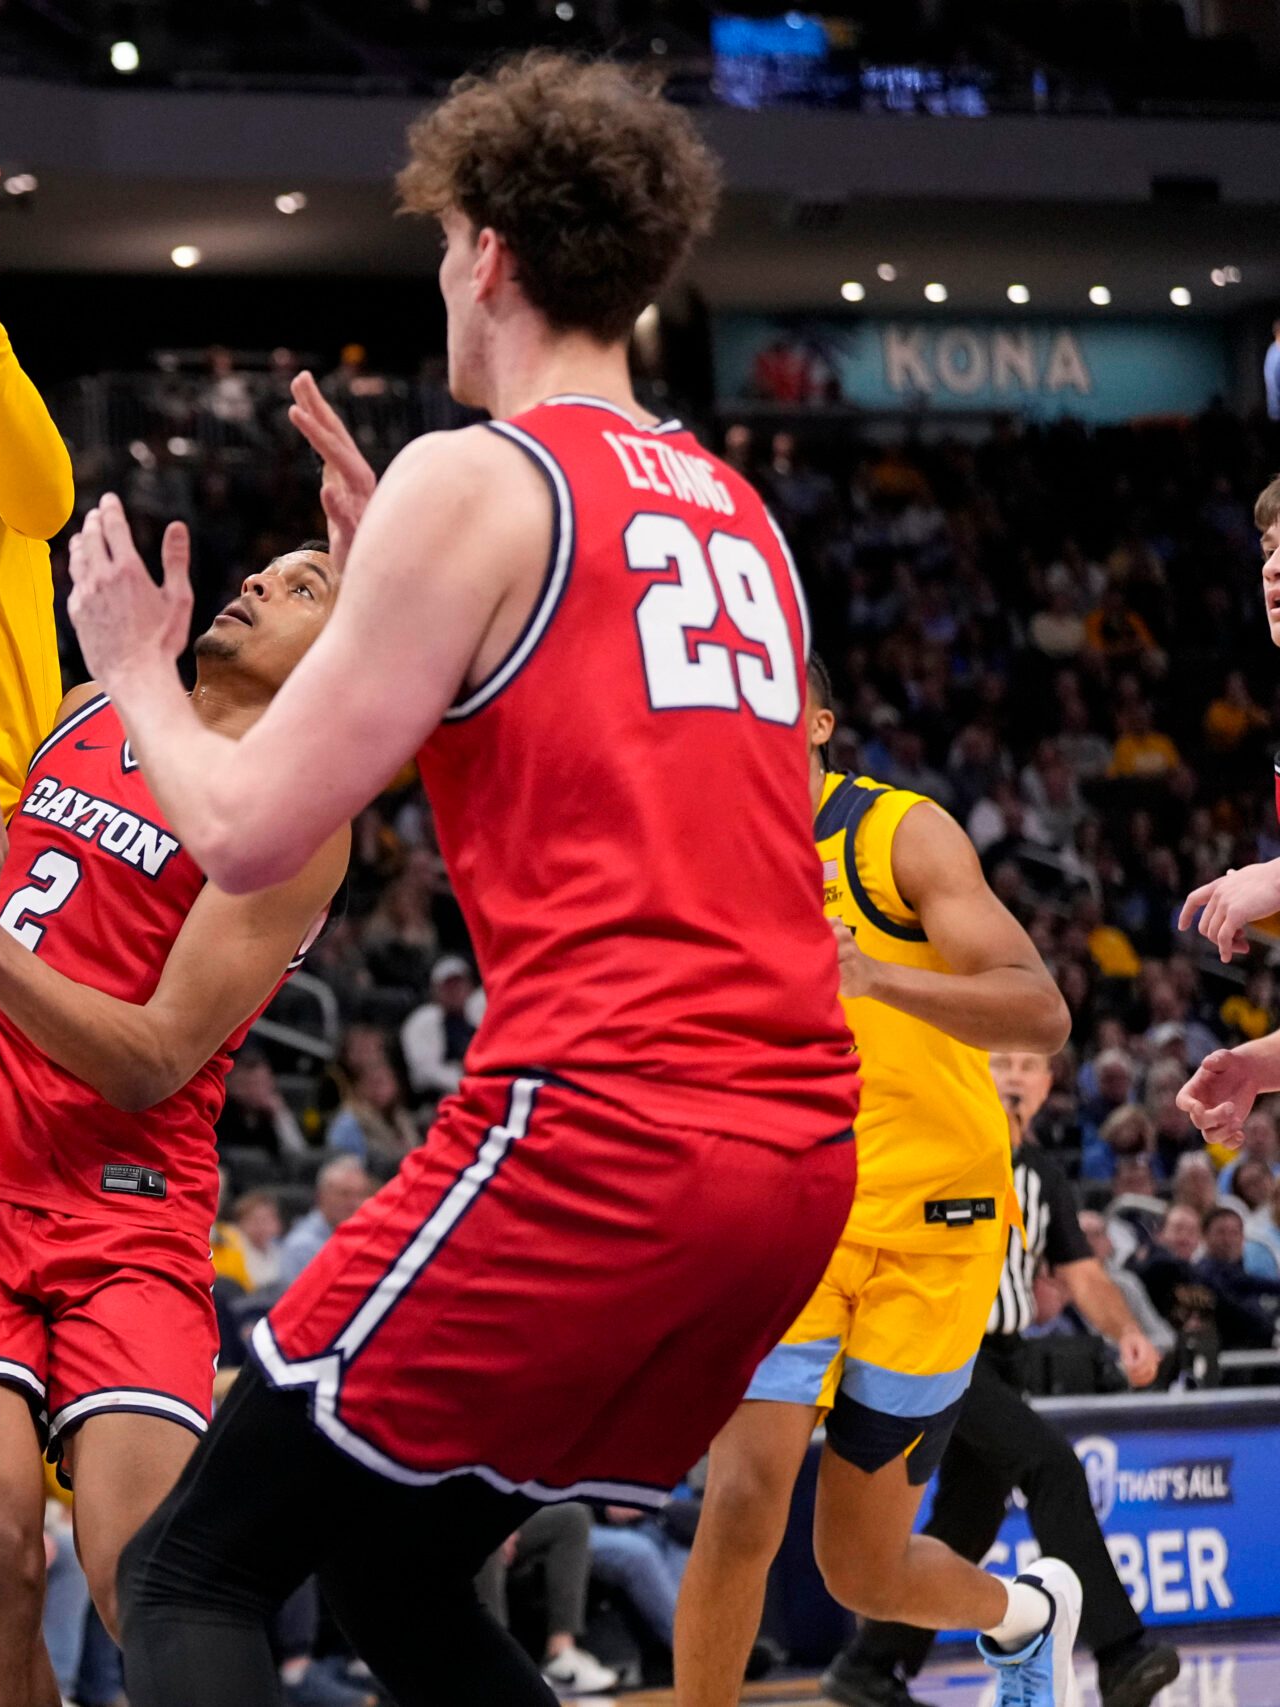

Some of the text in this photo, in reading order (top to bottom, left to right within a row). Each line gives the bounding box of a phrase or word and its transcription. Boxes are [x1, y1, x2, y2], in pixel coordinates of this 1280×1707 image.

[883, 325, 1091, 395] KONA
[601, 430, 737, 517] LETANG
[622, 511, 801, 728] 29
[21, 775, 182, 882] DAYTON
[148, 1175, 155, 1187] L
[1116, 1465, 1229, 1503] THAT'S ALL
